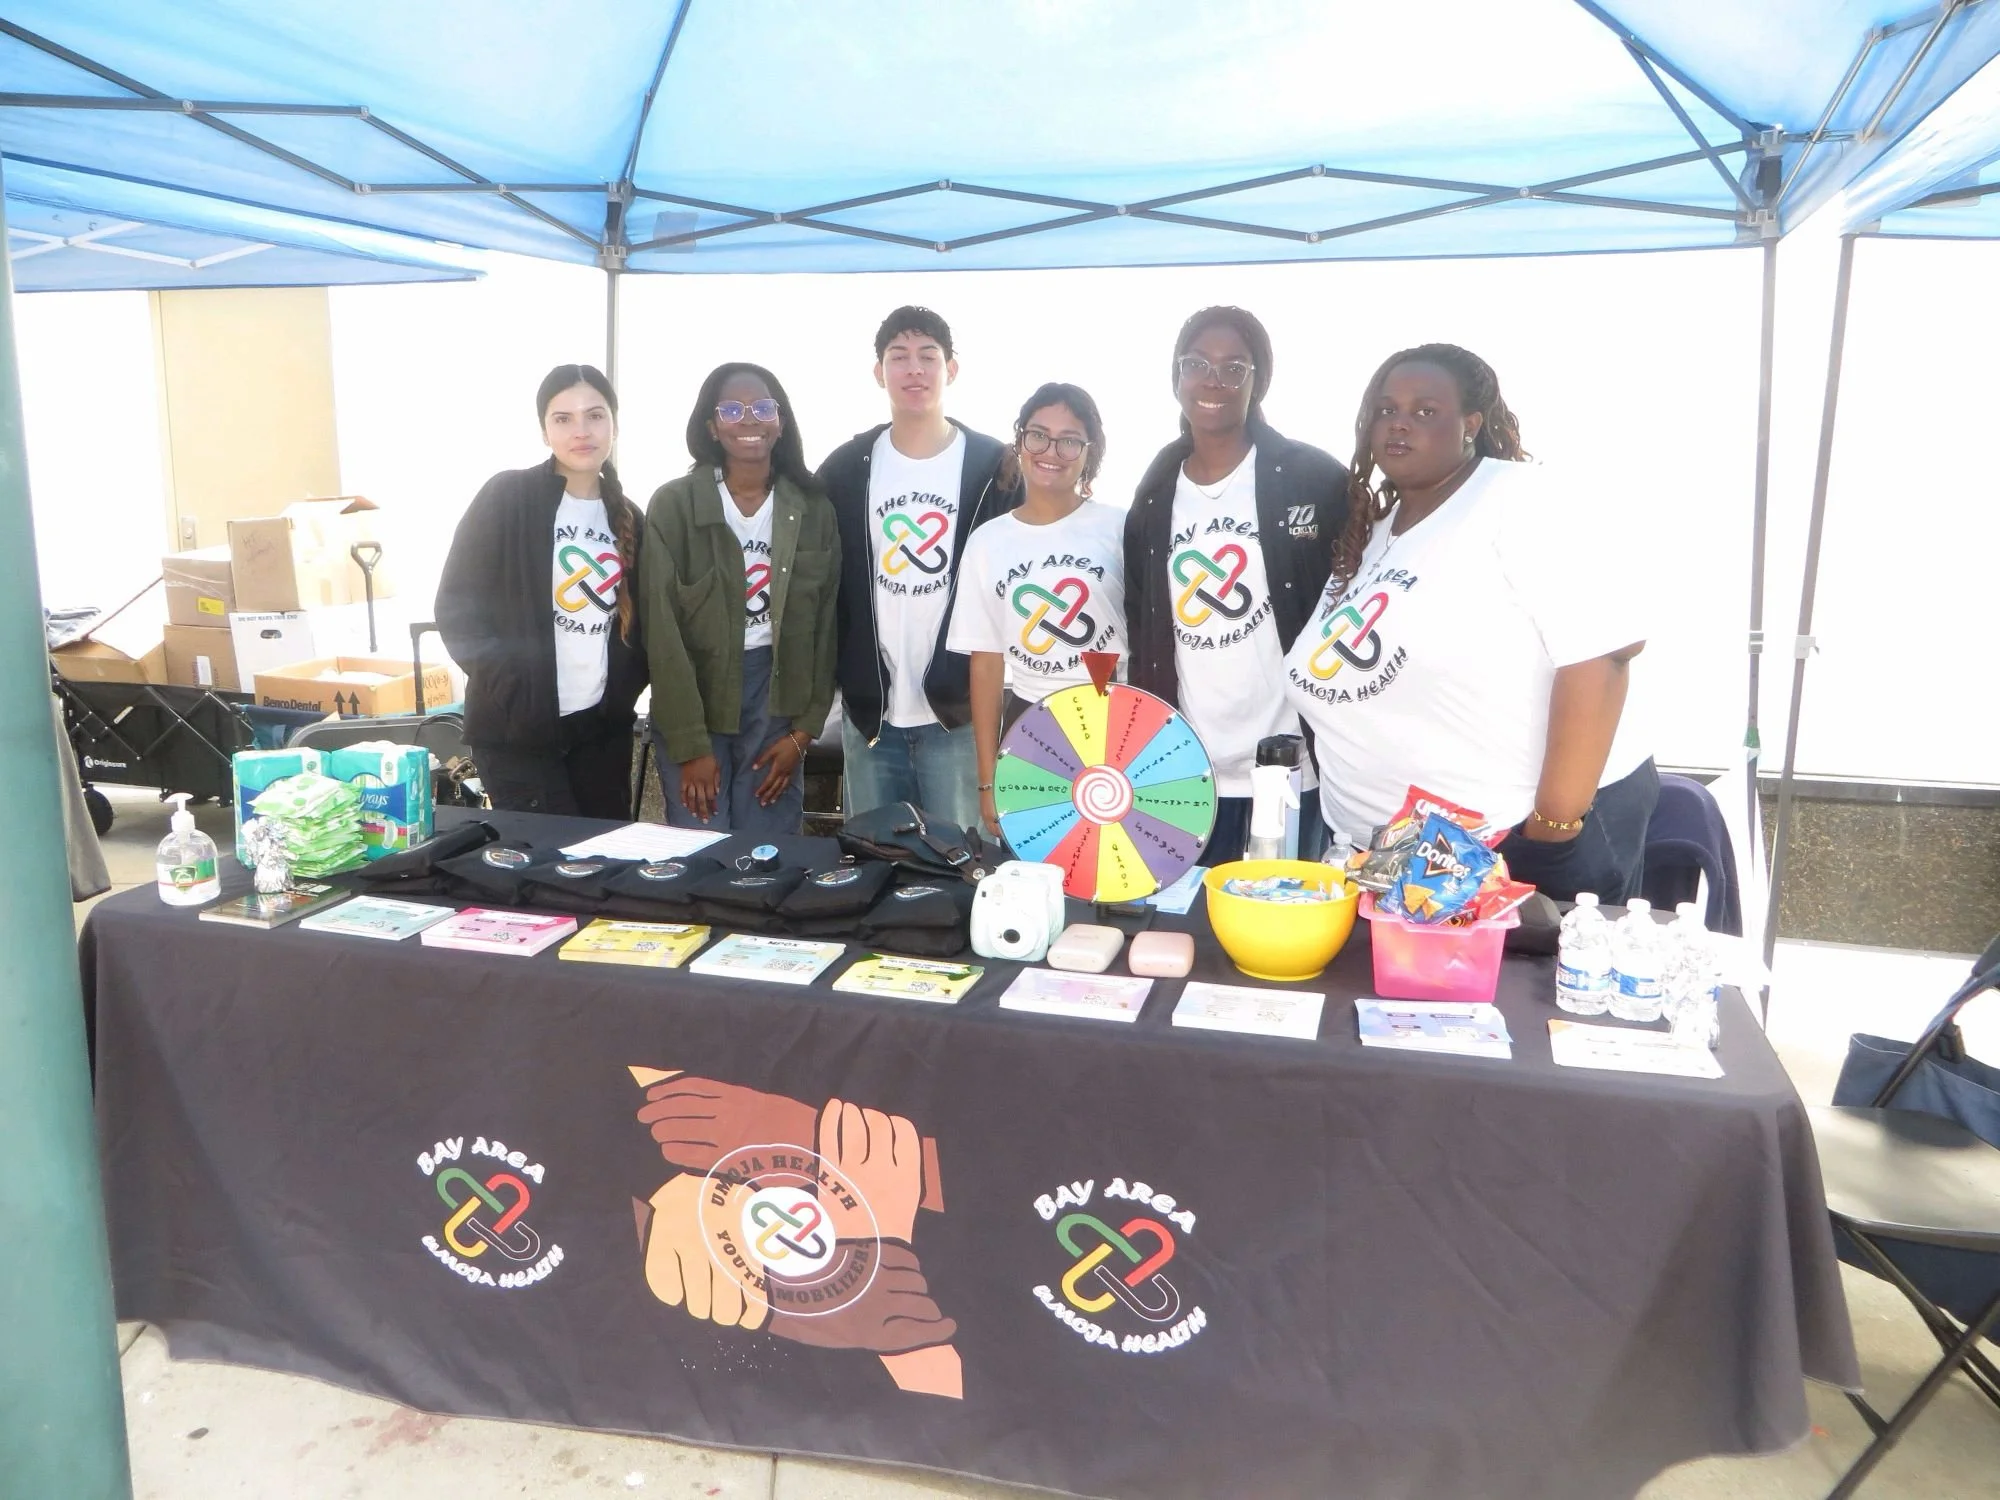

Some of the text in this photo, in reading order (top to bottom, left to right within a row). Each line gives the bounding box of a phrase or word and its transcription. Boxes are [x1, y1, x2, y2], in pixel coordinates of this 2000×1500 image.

[876, 491, 957, 518] THE TOWN
[555, 525, 579, 542] AY
[743, 539, 772, 556] AR
[877, 573, 952, 596] MOJA HEAL
[995, 554, 1106, 599] BAY AREA
[553, 610, 586, 633] OJA
[1173, 594, 1274, 650] MOJA HEALTH
[1008, 624, 1117, 675] UMOJA HLTH
[1289, 646, 1409, 704] UMOJA HEALTH
[1072, 696, 1091, 740] COVID
[1115, 697, 1143, 762] HEPATITIS
[359, 794, 390, 810] ways
[1134, 795, 1210, 807] CHLAMYDIA
[1135, 822, 1185, 862] SNACKS
[1416, 841, 1471, 879] Doritos
[1112, 843, 1129, 888] COVID
[416, 1136, 545, 1184] BAY AREA
[711, 1155, 858, 1211] UMOJA HEALTH
[1033, 1177, 1196, 1234] BAY AREA
[421, 1235, 564, 1288] UMOJA HEALTH
[717, 1230, 766, 1292] YOUTH
[1032, 1285, 1207, 1353] UMOJA HEALTH
